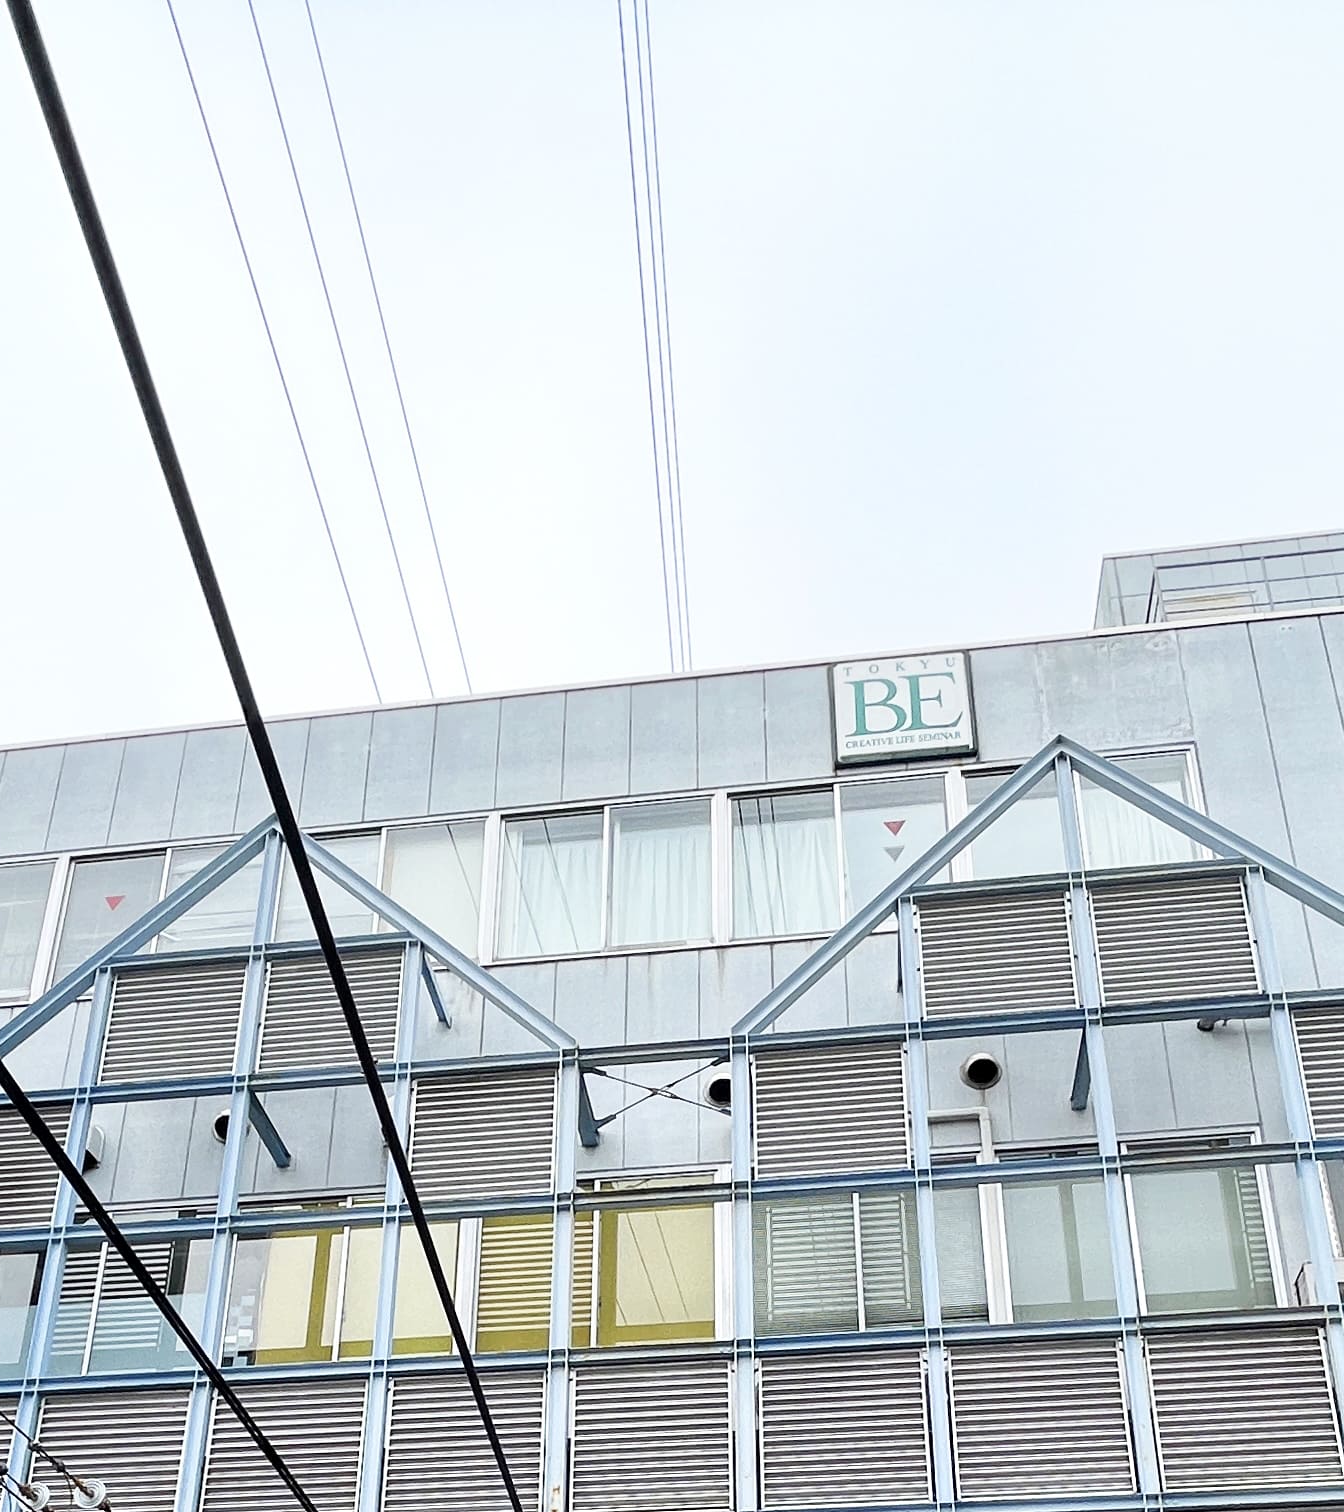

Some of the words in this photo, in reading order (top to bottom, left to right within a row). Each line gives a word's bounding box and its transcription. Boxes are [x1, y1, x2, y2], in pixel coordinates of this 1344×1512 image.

[844, 658, 956, 676] TOKYU
[844, 672, 963, 737] BE
[846, 736, 894, 749] CREATIVE
[895, 735, 916, 745] LIFE
[918, 731, 961, 742] SEMINAR
